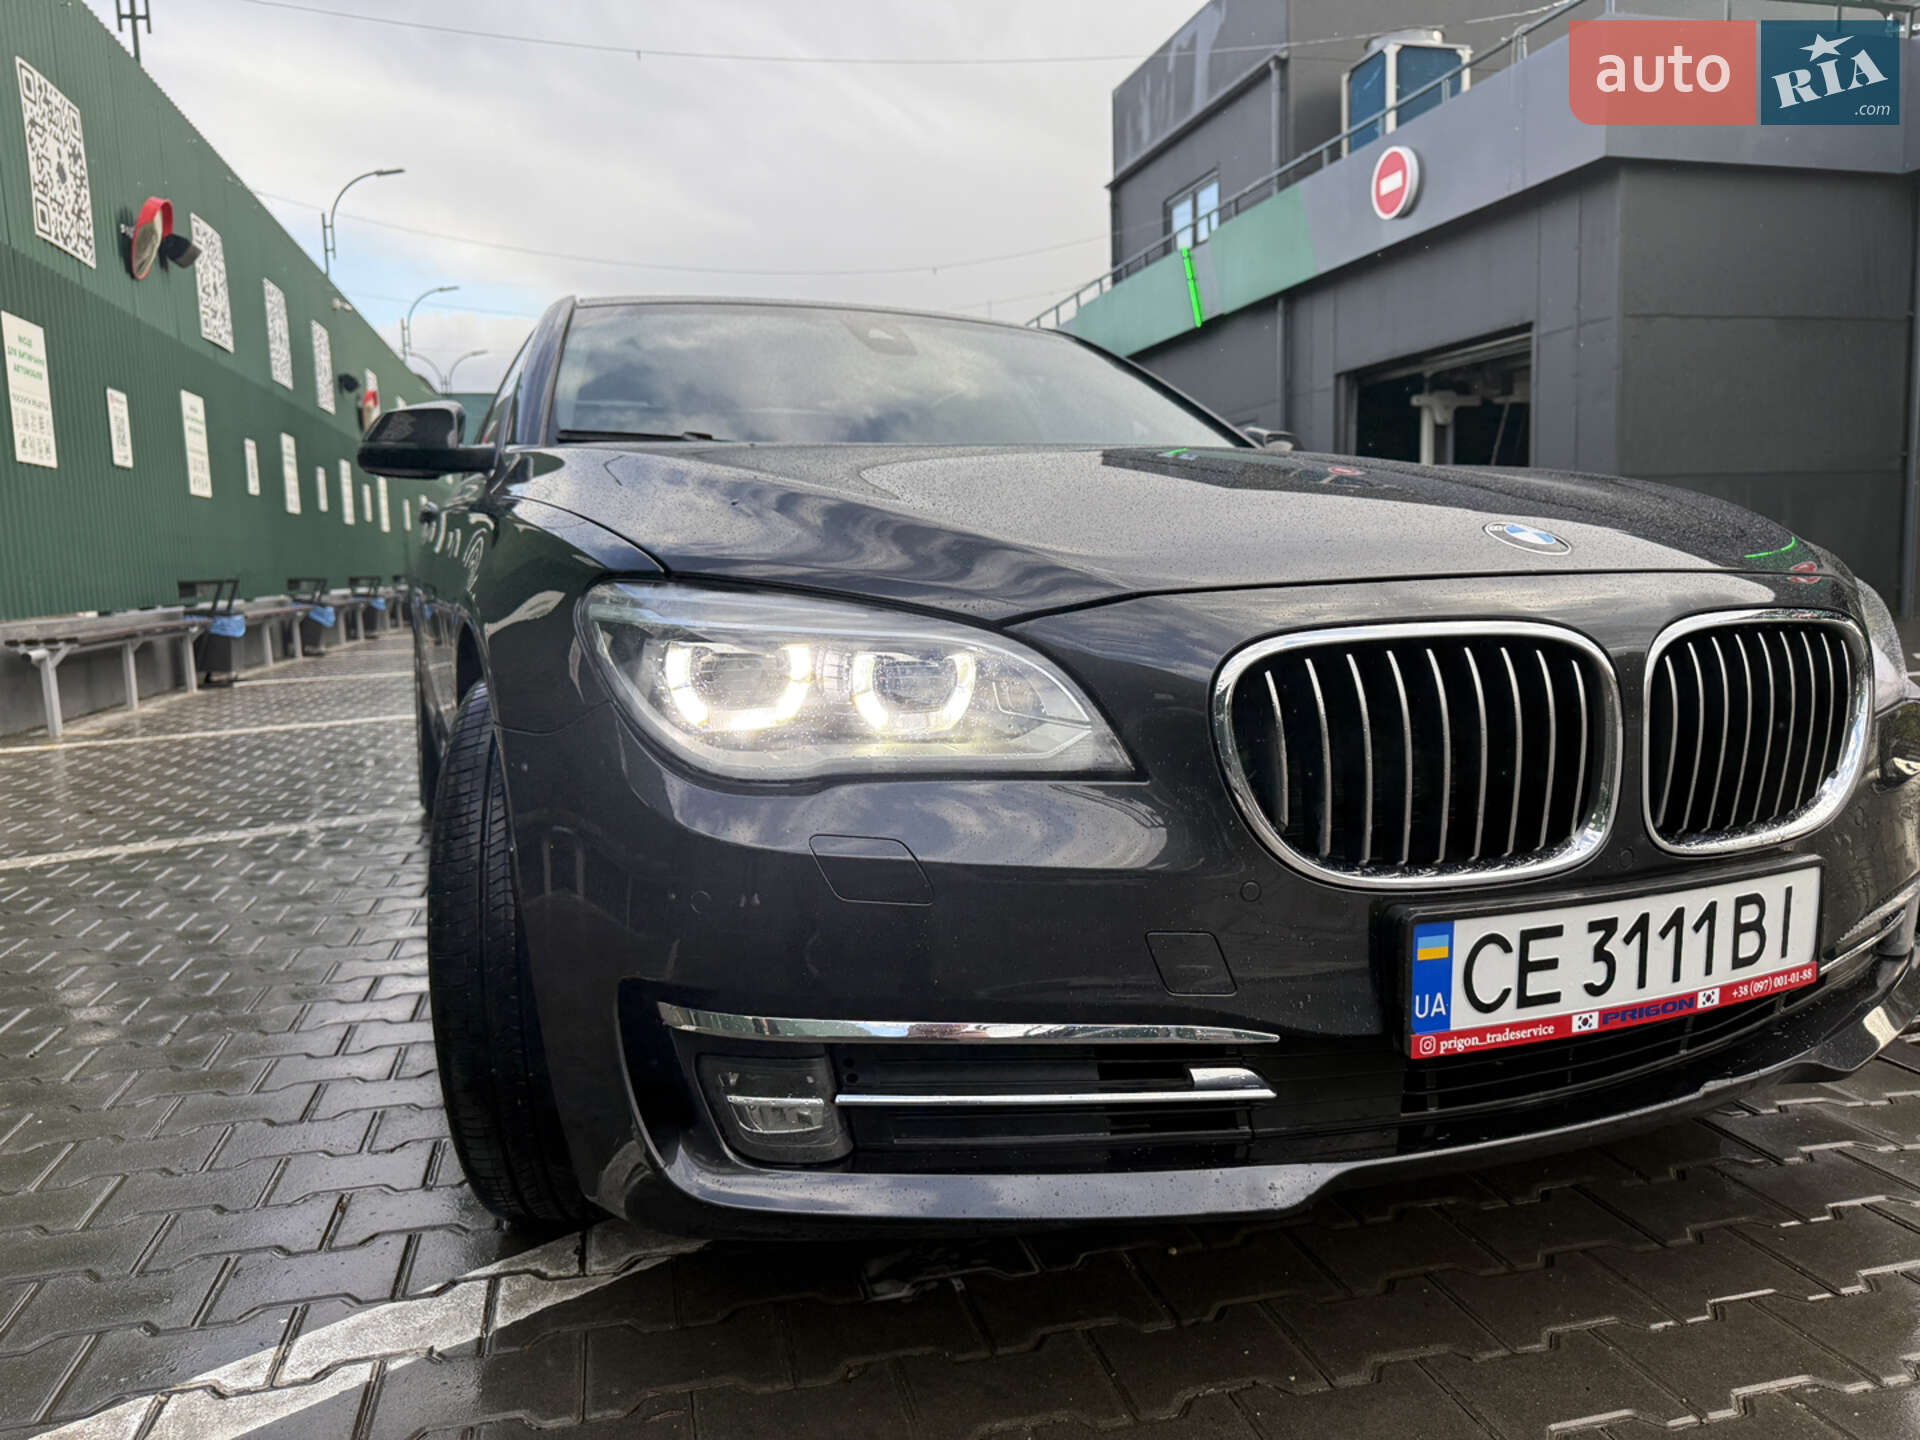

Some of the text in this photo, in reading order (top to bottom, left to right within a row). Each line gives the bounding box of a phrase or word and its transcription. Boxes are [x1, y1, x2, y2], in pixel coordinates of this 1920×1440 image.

[1463, 885, 1793, 1014] CE 3111 BI
[1414, 991, 1447, 1019] UA
[1731, 984, 1749, 999] +38
[1602, 996, 1695, 1025] PRIGON
[1439, 1023, 1556, 1054] prigon_tradeservice
